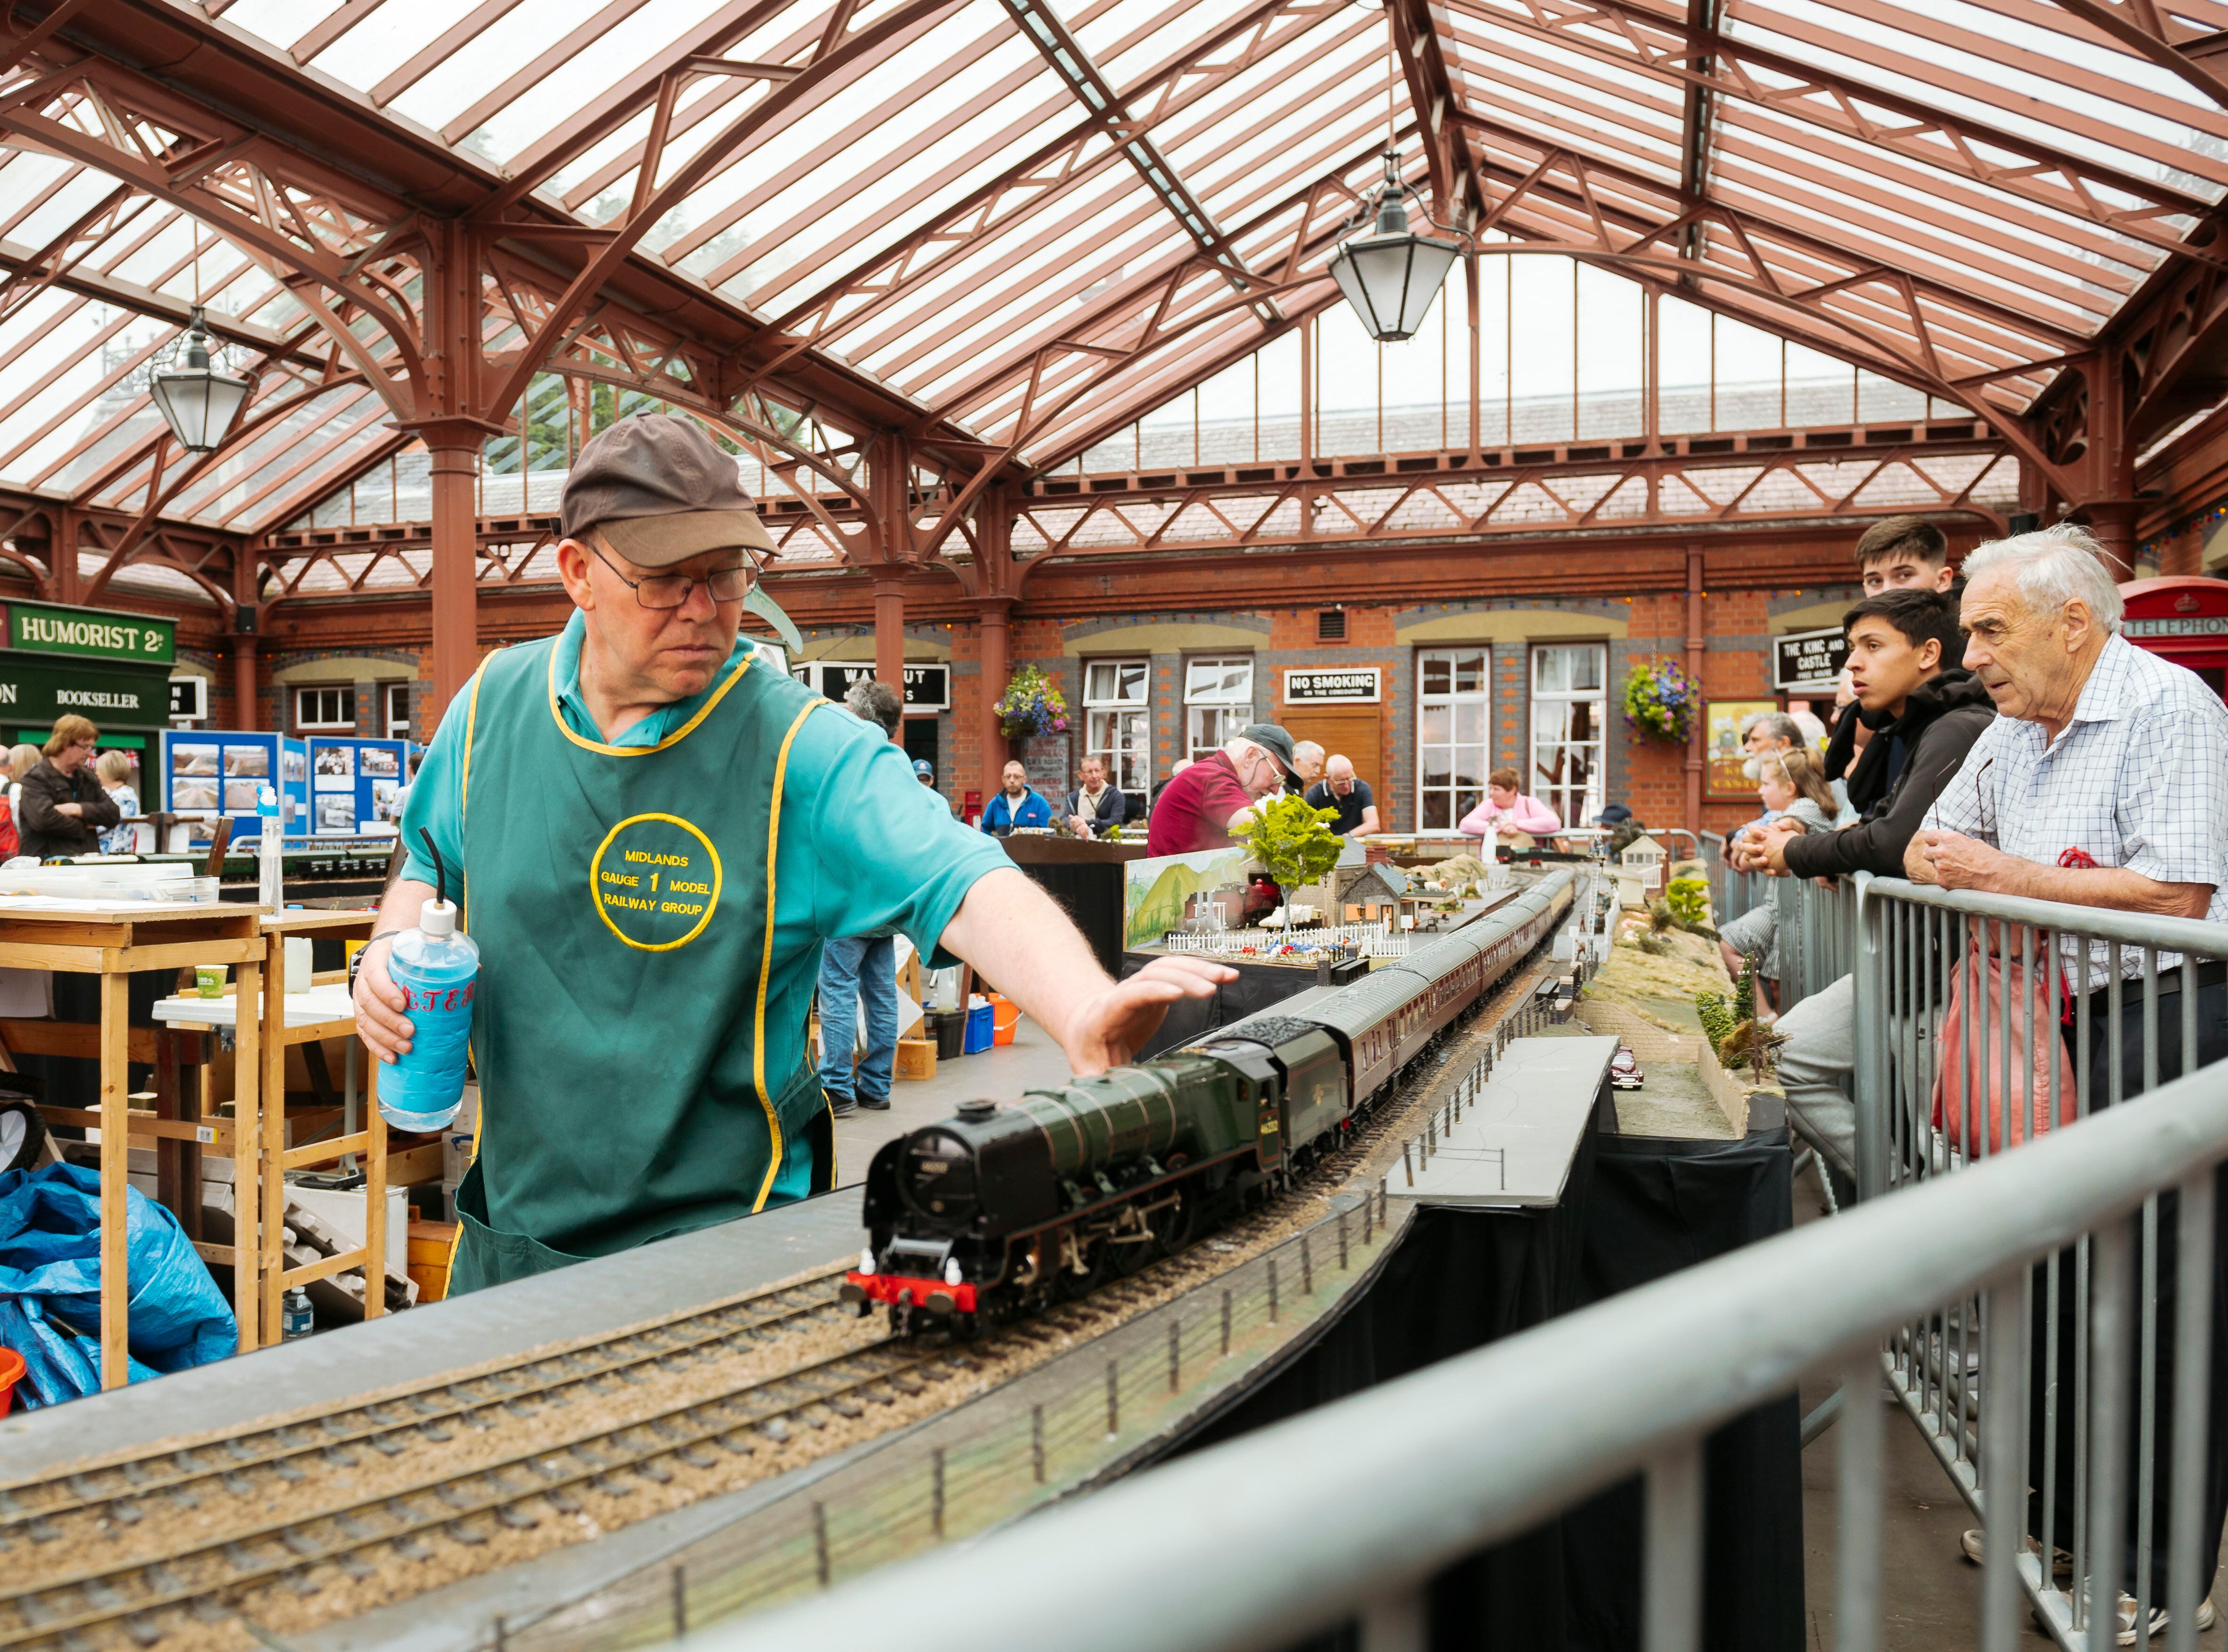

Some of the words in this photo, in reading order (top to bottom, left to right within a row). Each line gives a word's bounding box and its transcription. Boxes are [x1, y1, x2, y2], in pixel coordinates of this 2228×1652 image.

[22, 617, 140, 650] HUMORIST
[1784, 642, 1801, 657] THE
[1803, 639, 1825, 654] KING
[1828, 639, 1845, 652] AND
[1797, 653, 1831, 671] CASTLE
[903, 670, 925, 684] UT
[1291, 676, 1310, 689] NO
[1312, 674, 1373, 688] SMOKING
[56, 689, 139, 709] BOOKSELLER
[625, 850, 689, 867] MIDLANDS
[601, 871, 640, 887] GAUGE
[650, 873, 659, 892] 1
[669, 880, 711, 894] MODEL
[604, 893, 657, 911] RAILWAY
[661, 901, 703, 915] GROUP
[394, 980, 475, 1012] ATER
